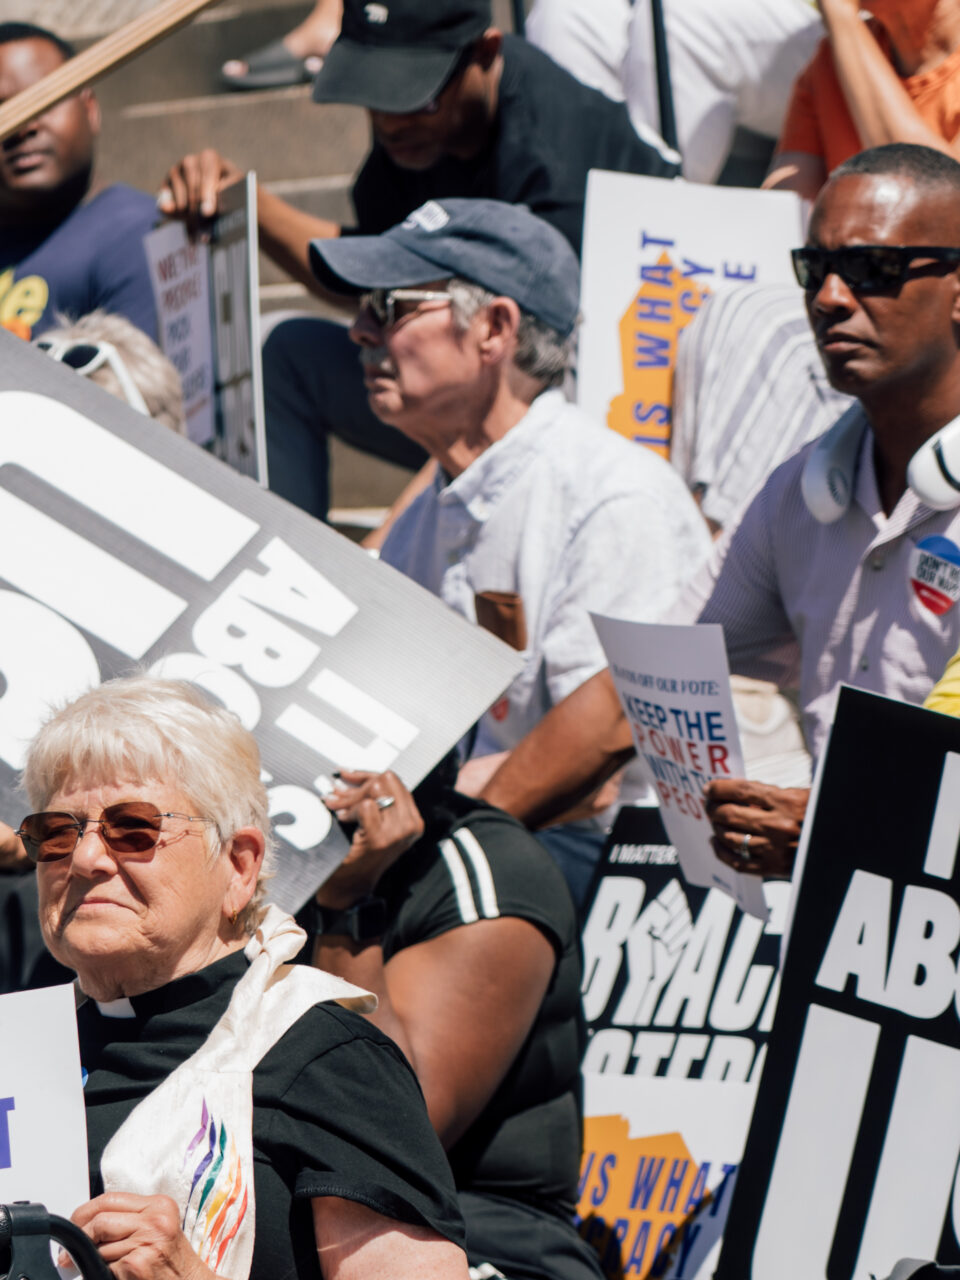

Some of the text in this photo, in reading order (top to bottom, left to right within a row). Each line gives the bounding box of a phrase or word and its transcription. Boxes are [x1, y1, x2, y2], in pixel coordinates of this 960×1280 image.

[634, 231, 675, 446] IS WHAT
[656, 677, 678, 694] OUR
[623, 692, 727, 742] KEEP THE
[637, 727, 731, 774] POWER
[643, 752, 690, 785] WITH
[629, 1156, 738, 1217] WHAT
